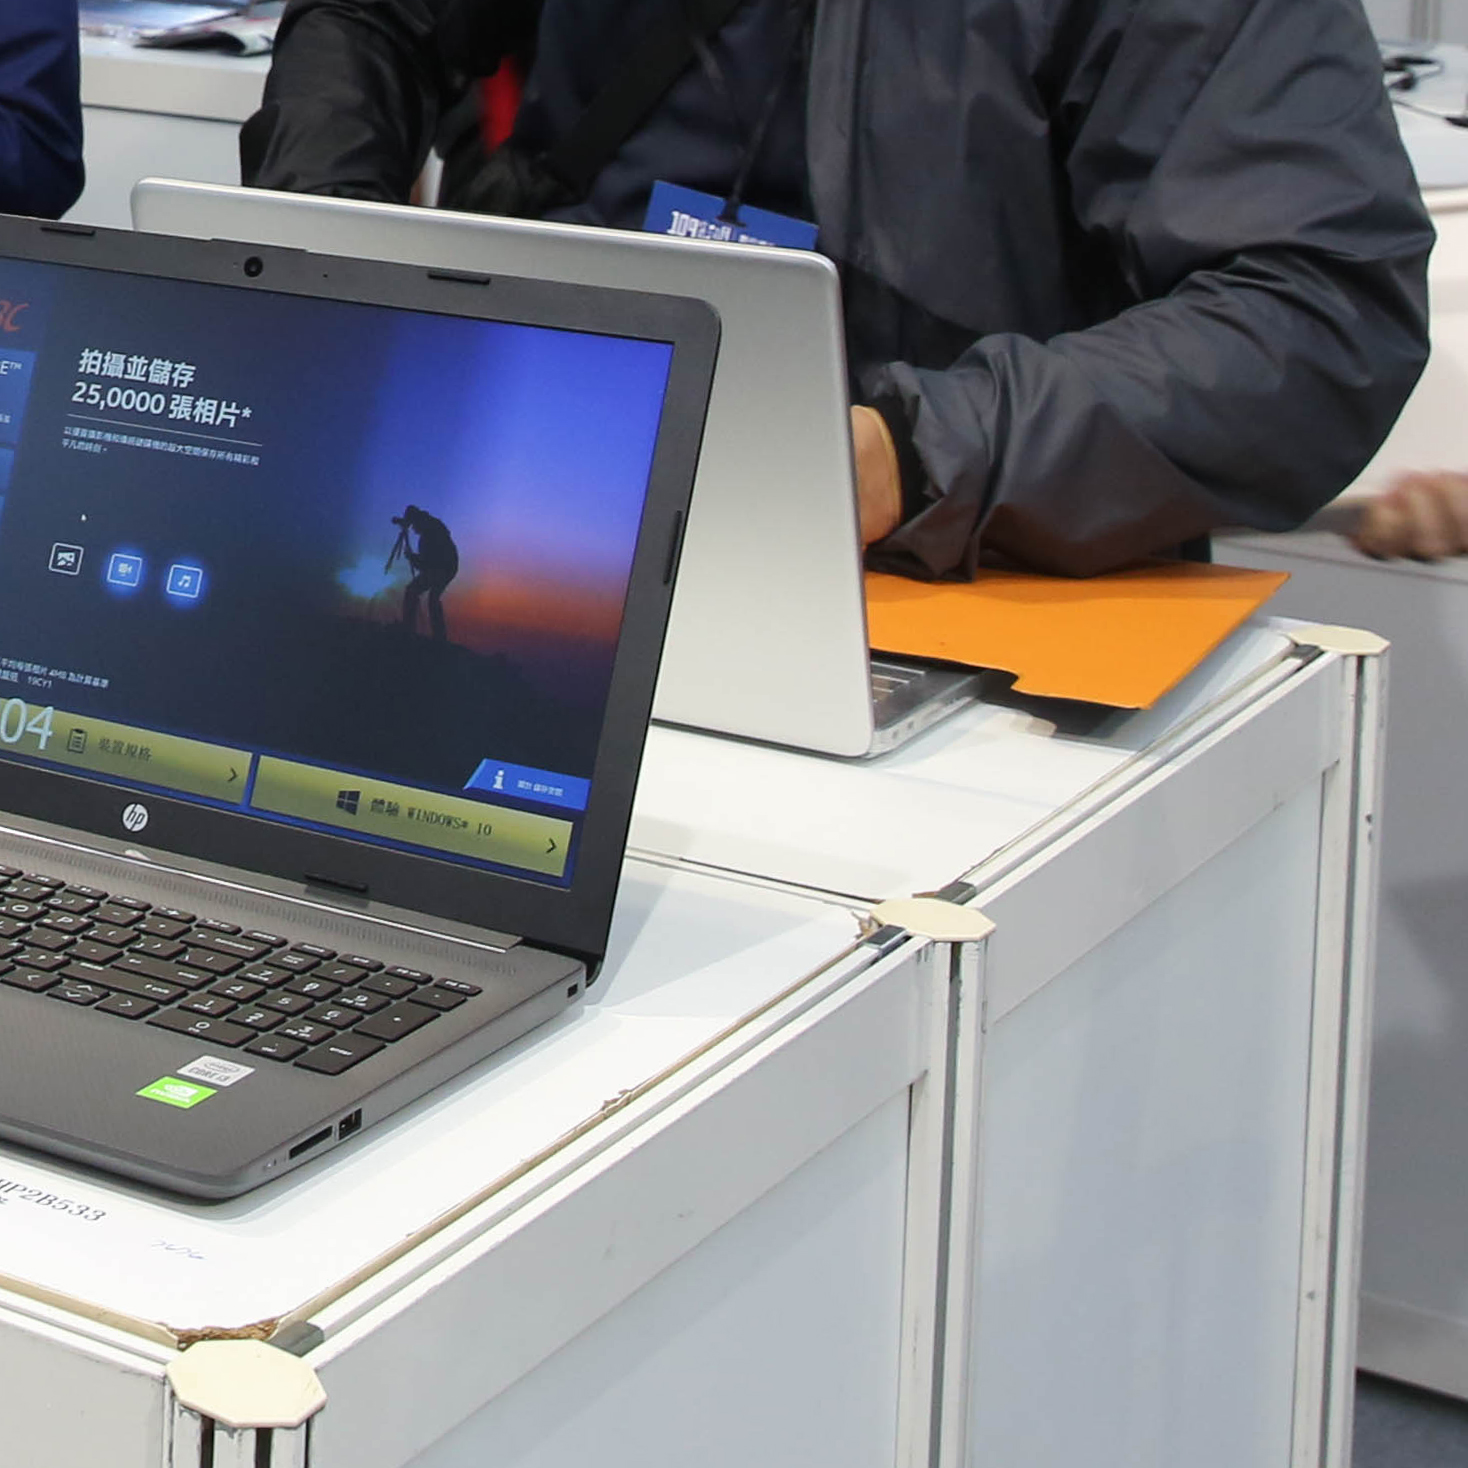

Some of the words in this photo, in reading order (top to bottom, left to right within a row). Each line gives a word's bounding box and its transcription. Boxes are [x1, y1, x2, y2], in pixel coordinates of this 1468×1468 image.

[78, 348, 196, 389] 拍攝並儲存
[98, 738, 152, 762] 裝置規格
[122, 803, 148, 831] hp
[476, 821, 492, 837] 10
